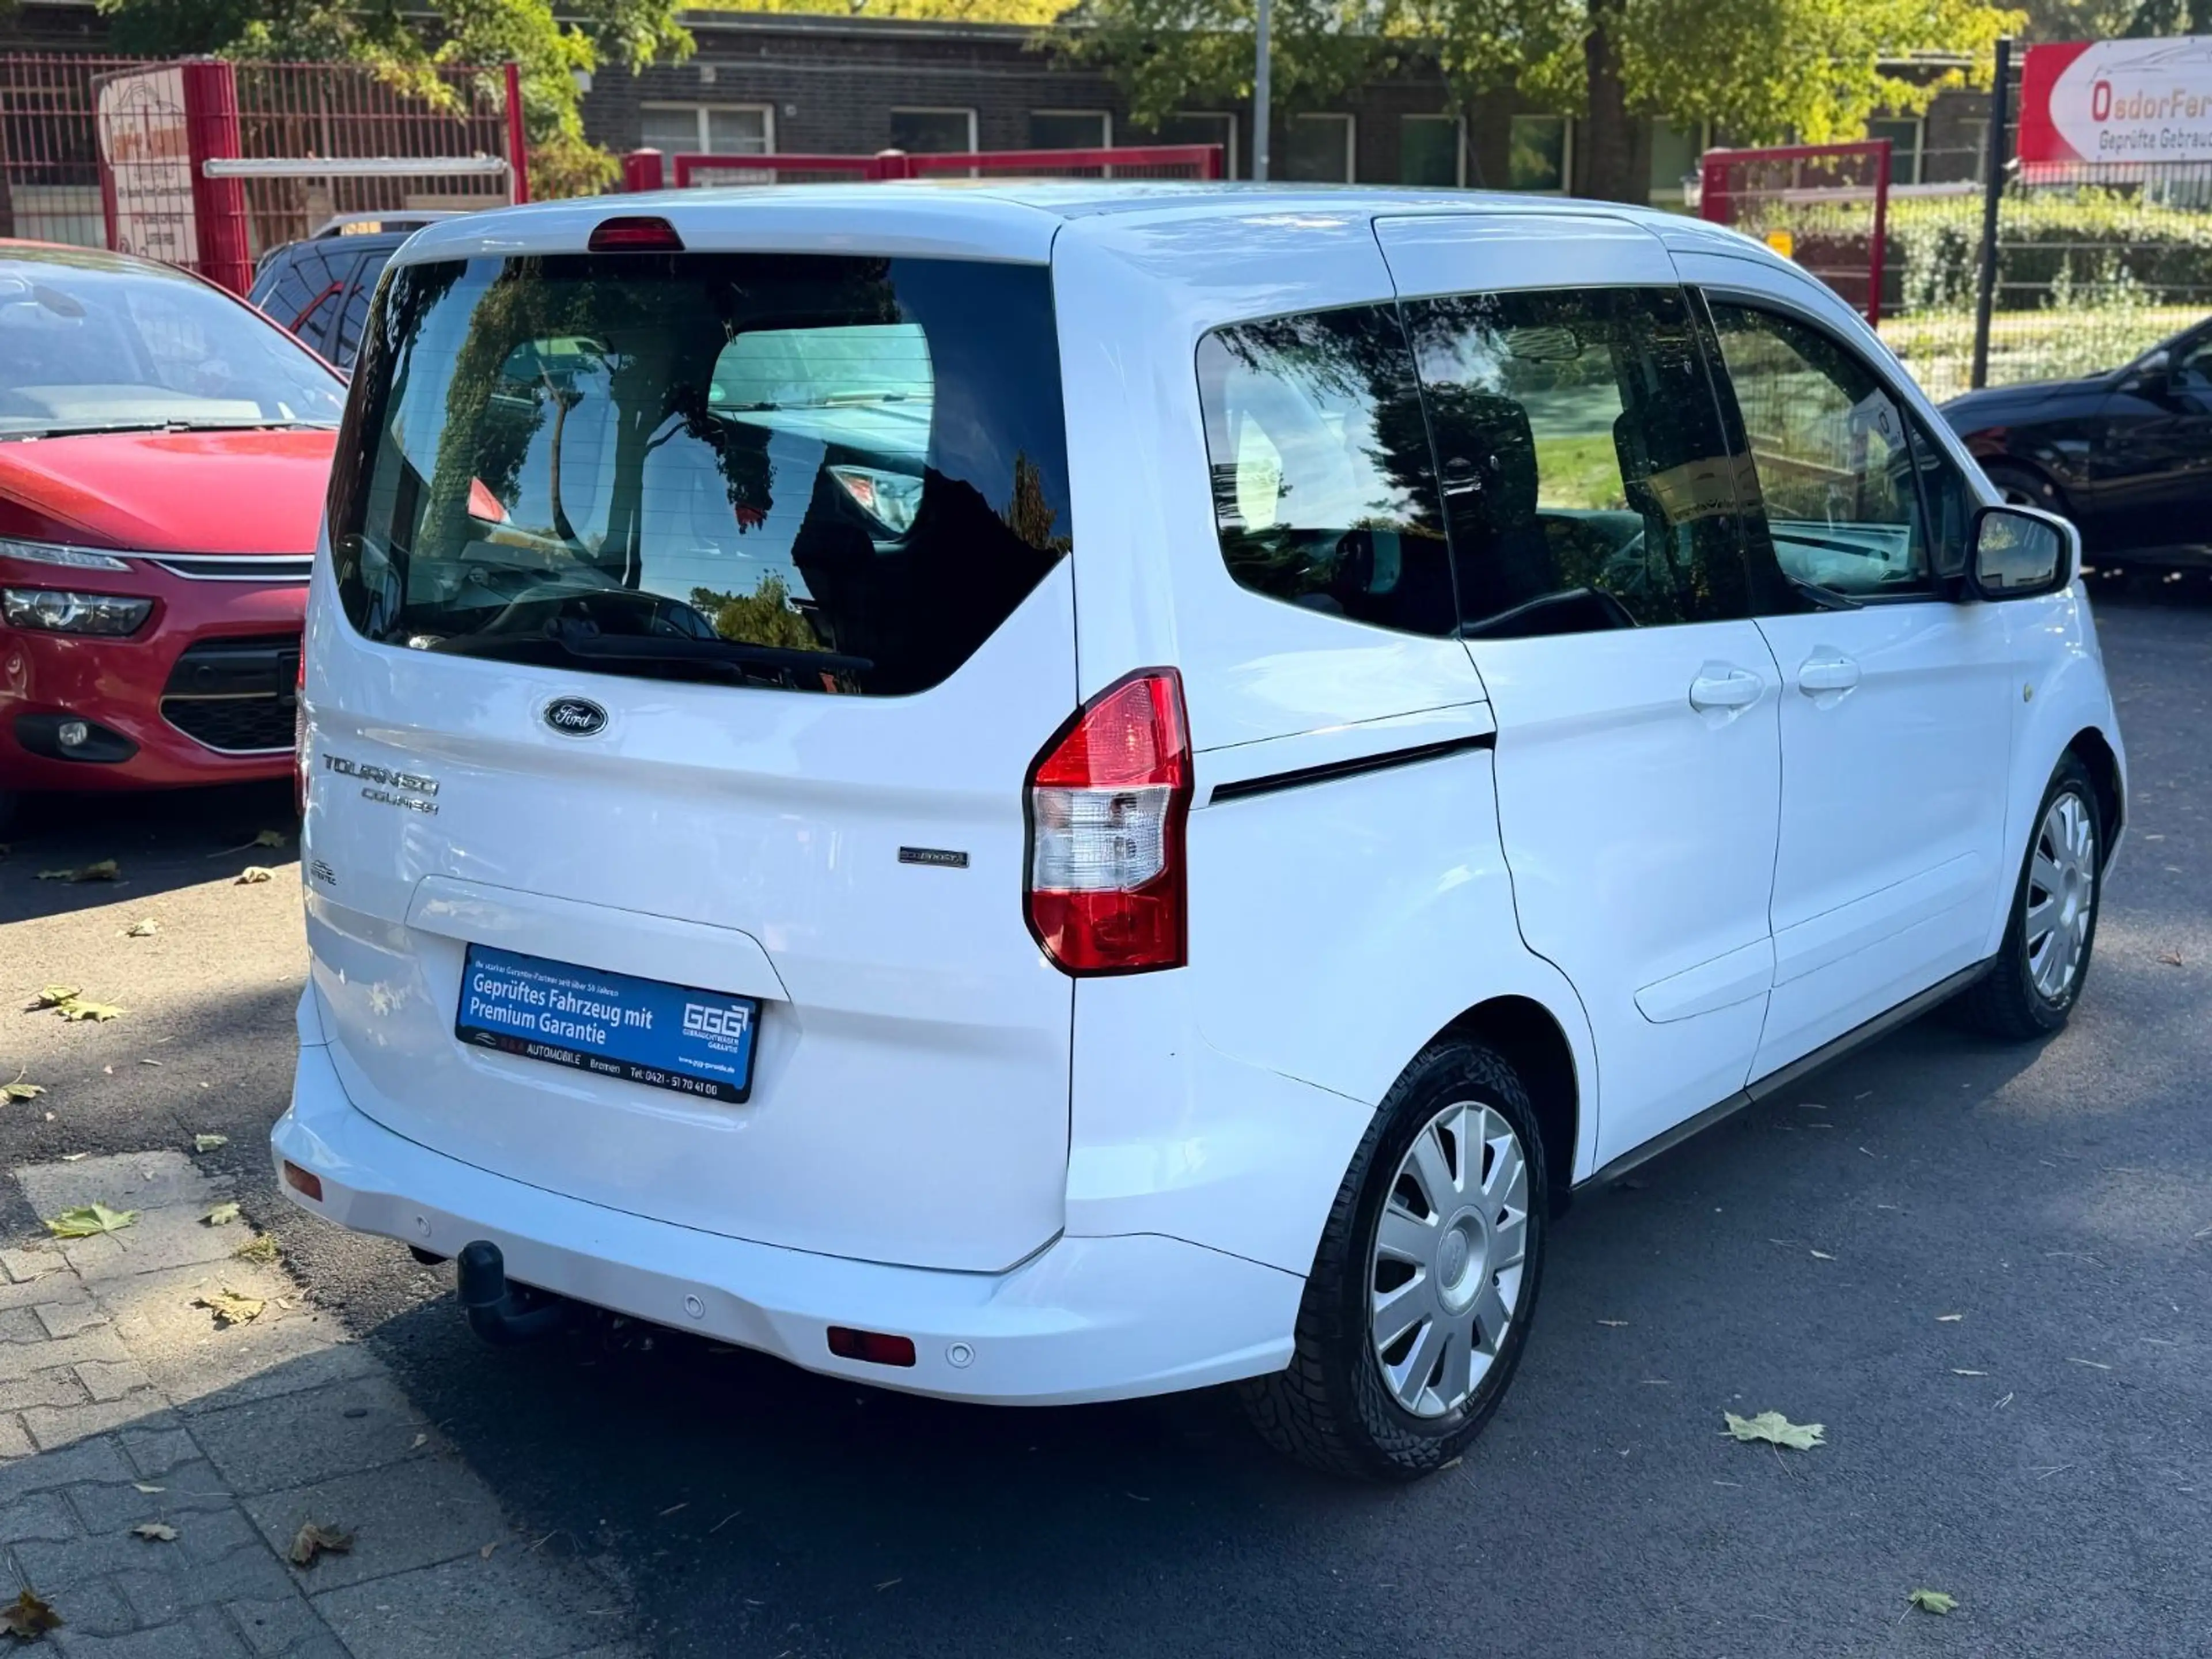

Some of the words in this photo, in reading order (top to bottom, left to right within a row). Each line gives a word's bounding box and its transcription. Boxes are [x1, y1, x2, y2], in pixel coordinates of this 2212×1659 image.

[2099, 128, 2156, 154] Geprüfte
[555, 704, 592, 727] Ford
[322, 753, 440, 797] TOURNEO
[361, 787, 440, 816] COURIER
[469, 997, 535, 1030] Premium
[539, 1013, 607, 1045] Garantie
[473, 973, 546, 1006] Geprüftes
[548, 988, 622, 1027] Fahrzeug
[624, 1007, 653, 1030] mit
[683, 1003, 743, 1037] GGG
[526, 1043, 581, 1065] AUTOMOBILE
[589, 1058, 621, 1074] Bremen
[645, 1070, 665, 1084] 0421
[682, 1078, 692, 1090] 70
[694, 1081, 704, 1093] 41
[704, 1084, 718, 1096] 00
